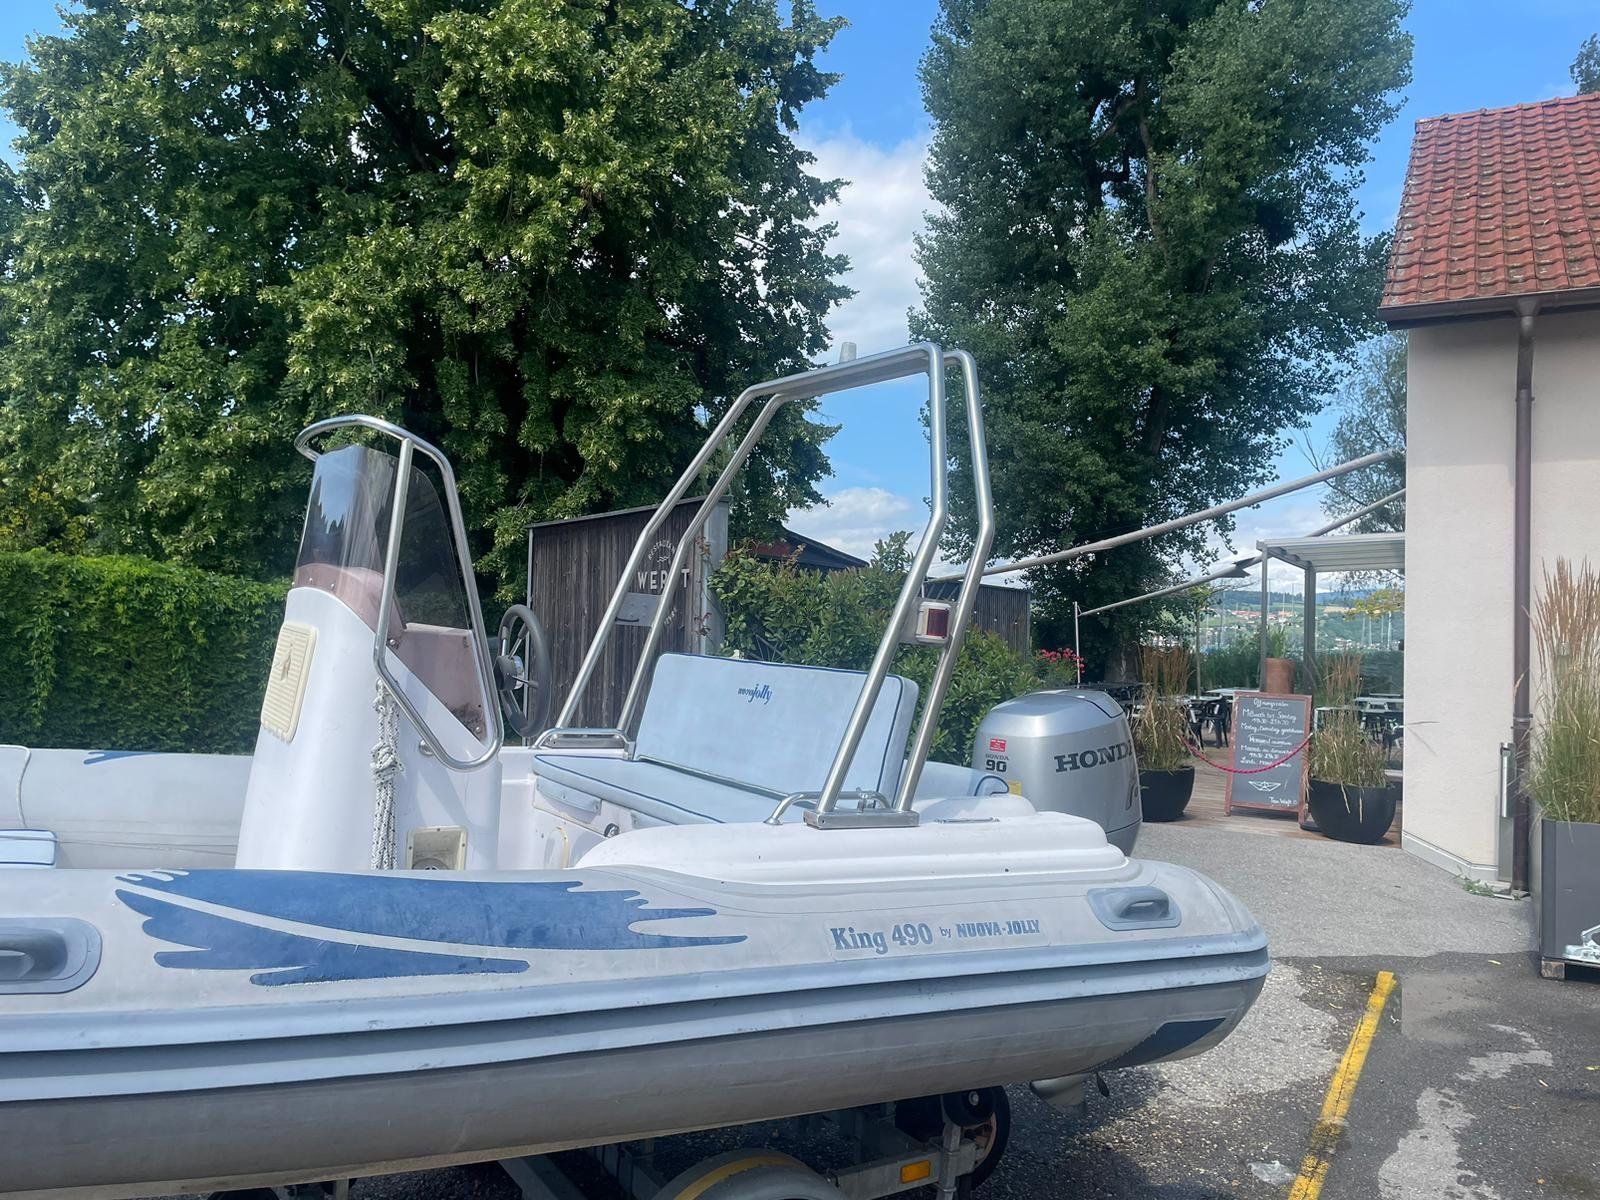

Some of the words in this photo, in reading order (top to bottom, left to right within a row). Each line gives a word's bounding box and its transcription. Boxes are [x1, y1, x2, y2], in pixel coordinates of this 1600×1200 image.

[648, 540, 677, 560] RESTAURAN
[637, 568, 690, 590] WERT
[985, 753, 1010, 761] HONDA
[985, 759, 1007, 773] 90
[830, 927, 888, 955] King
[892, 923, 934, 946] 490
[940, 926, 952, 938] by
[955, 919, 1041, 938] NUOVA-JOLLY
